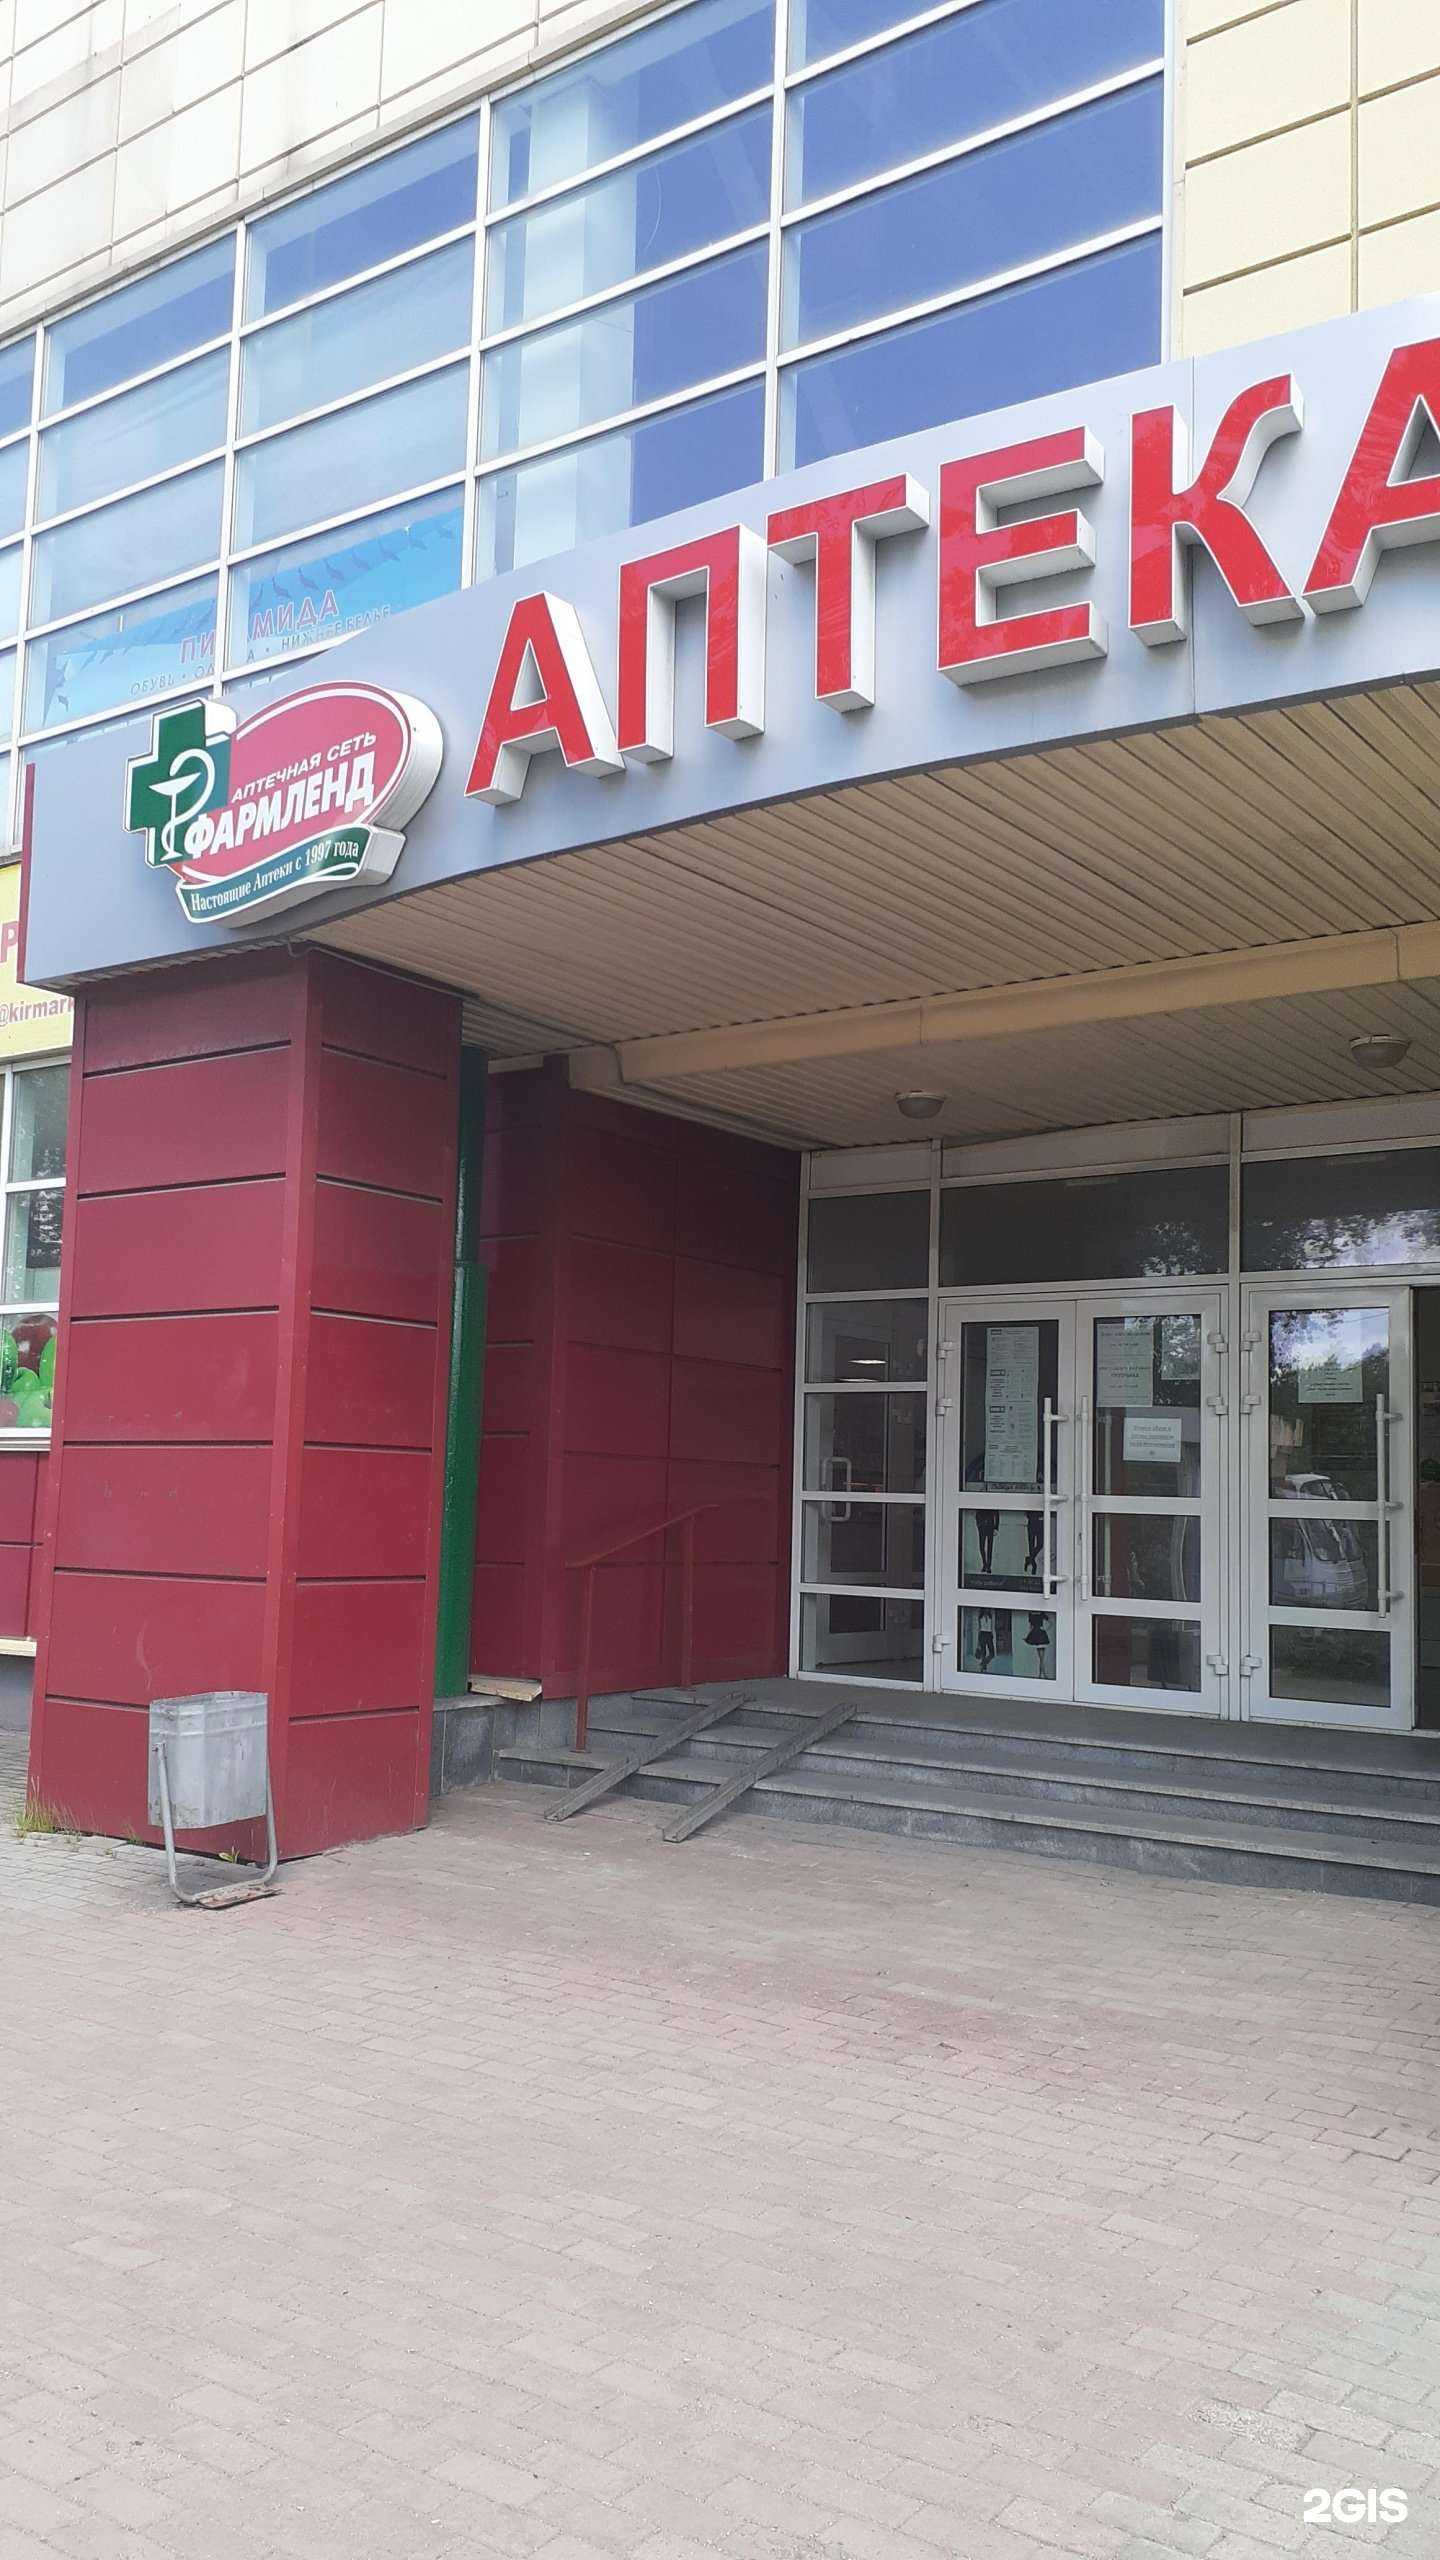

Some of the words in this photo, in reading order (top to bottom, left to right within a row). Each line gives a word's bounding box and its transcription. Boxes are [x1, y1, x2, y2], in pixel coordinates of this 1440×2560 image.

[466, 338, 1440, 802] АПТЕКА
[180, 589, 339, 665] ПИМИДА
[130, 671, 175, 696] ОБУВЬ
[231, 752, 322, 803] АПТЕЧНАЯ
[326, 732, 377, 762] СЕТЬ
[184, 750, 375, 860] ФАРМЛЕНД
[190, 884, 251, 912] Настоящие
[252, 862, 294, 892] Аптеки
[295, 855, 303, 870] с
[305, 839, 332, 866] 1997
[332, 839, 359, 859] года
